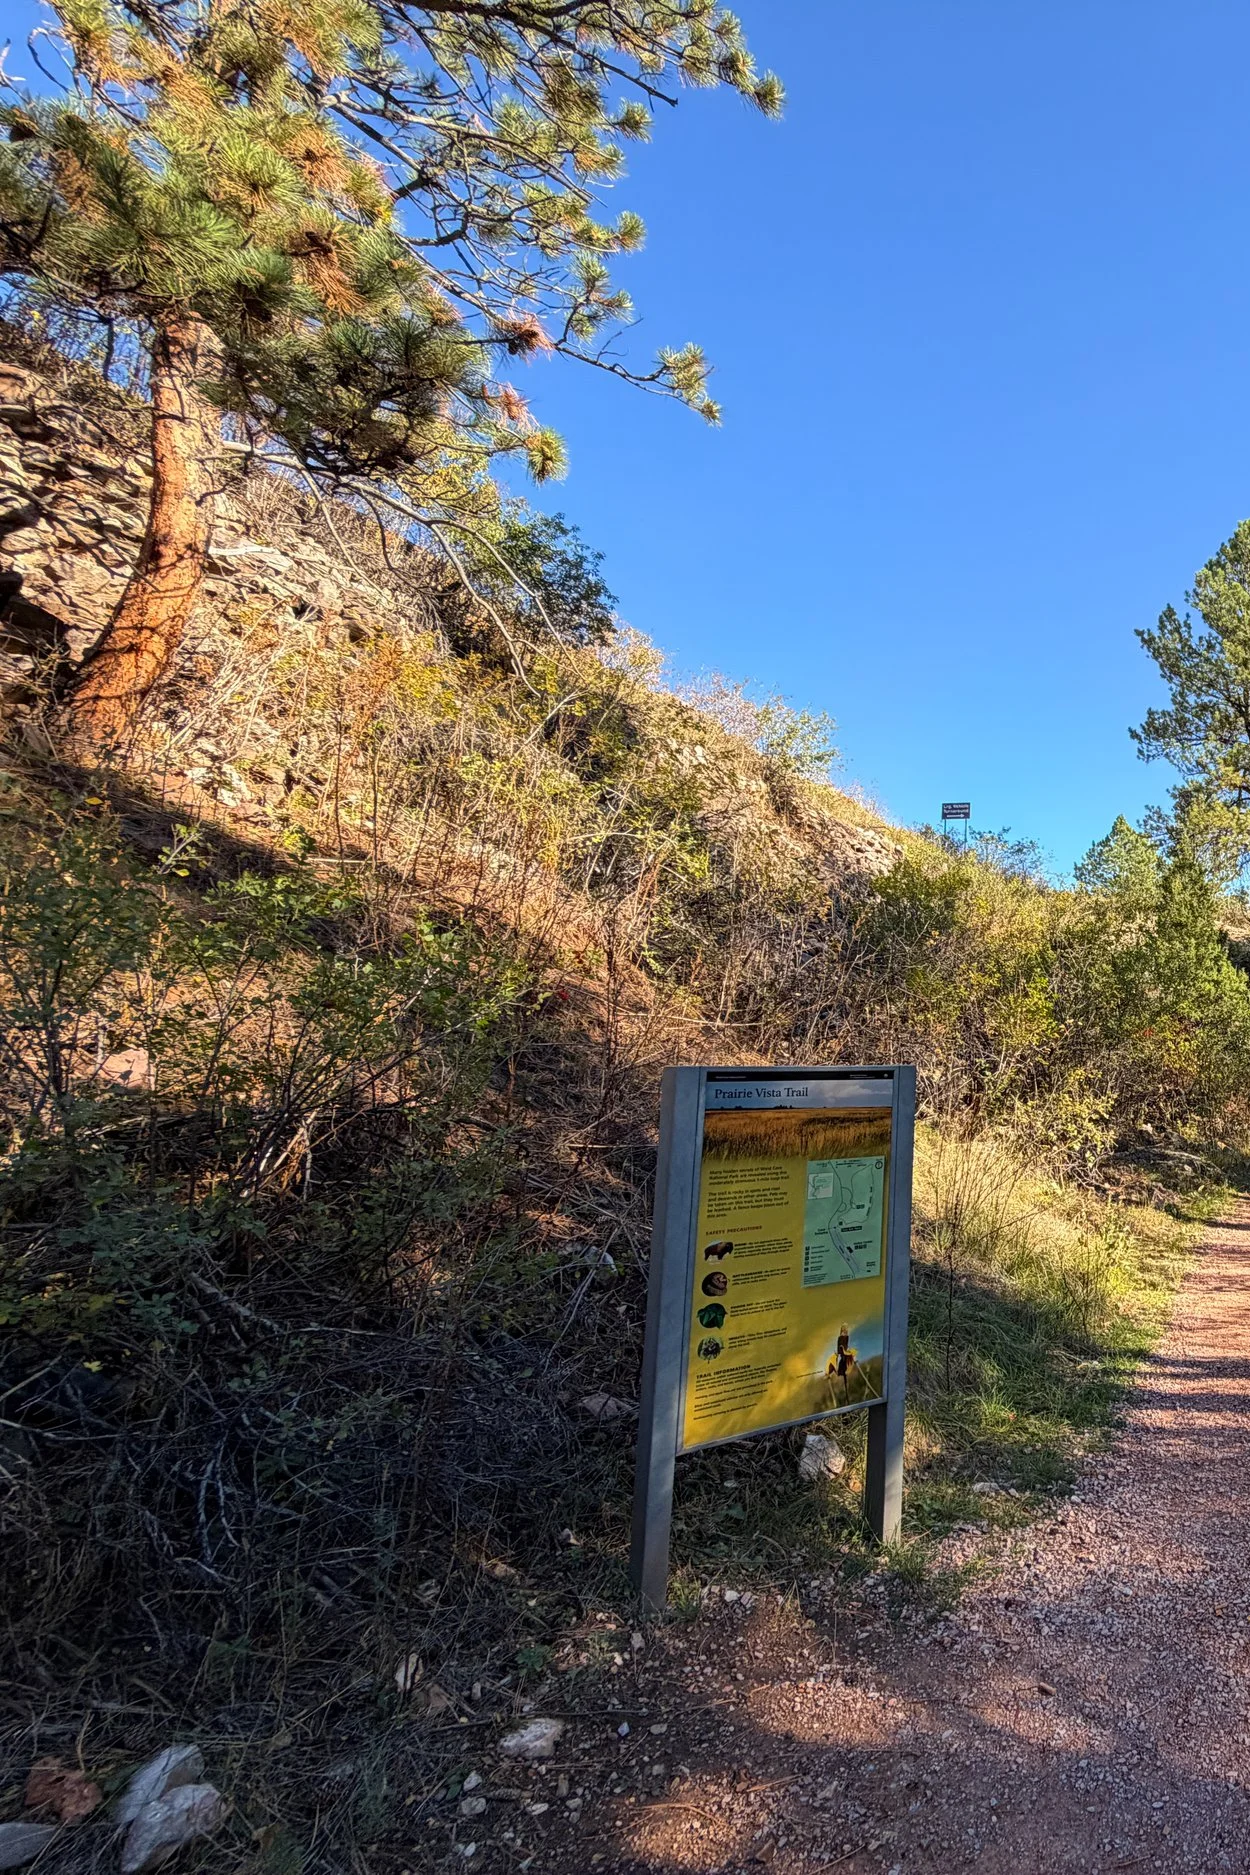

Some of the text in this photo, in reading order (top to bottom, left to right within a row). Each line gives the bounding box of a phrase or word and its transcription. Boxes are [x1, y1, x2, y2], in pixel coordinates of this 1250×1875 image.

[714, 1086, 809, 1099] Prairie Vista Trail
[726, 1225, 762, 1233] PRECAUTIONS
[696, 1364, 751, 1380] TRAIL INFORMATION
